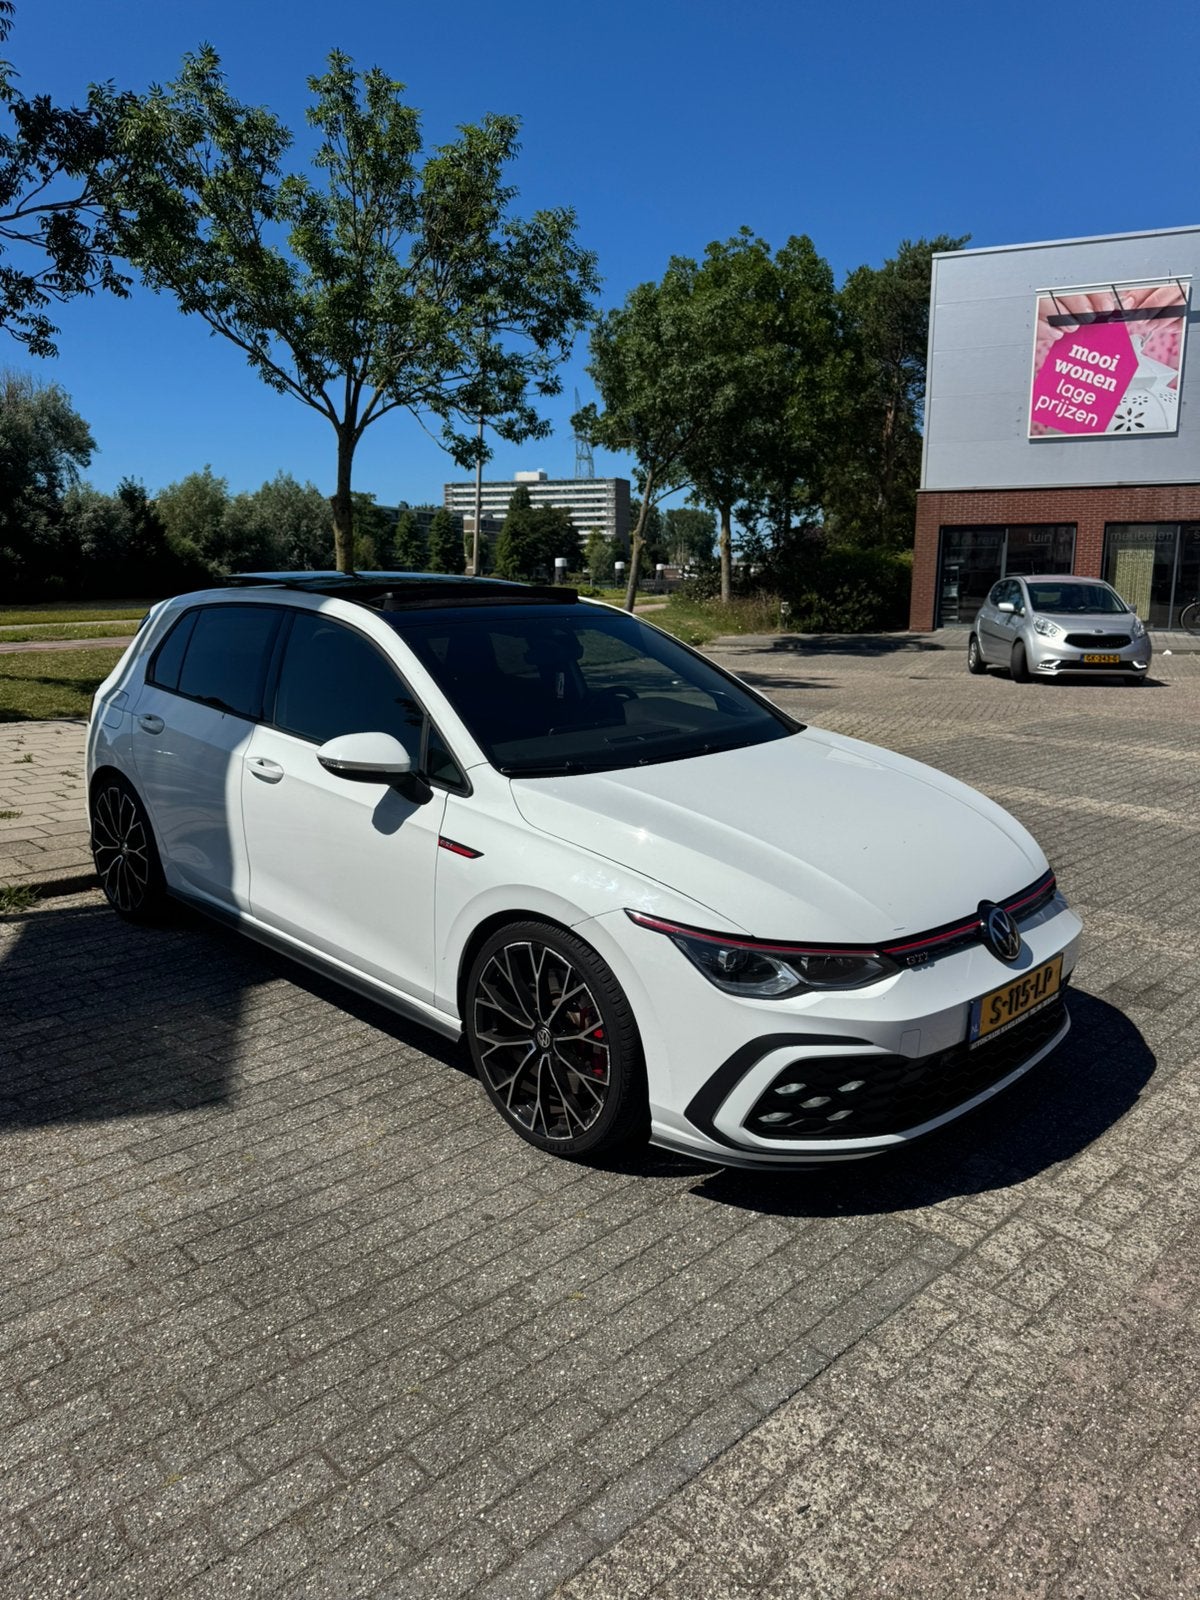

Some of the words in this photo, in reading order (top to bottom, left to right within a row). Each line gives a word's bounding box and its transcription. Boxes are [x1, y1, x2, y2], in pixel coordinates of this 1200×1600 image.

[1068, 344, 1121, 372] mooi
[1054, 359, 1117, 392] wonen
[1056, 378, 1096, 405] lage
[1034, 395, 1099, 427] prijzen
[1028, 531, 1053, 543] tuin
[989, 966, 1054, 1025] S-115-LP
